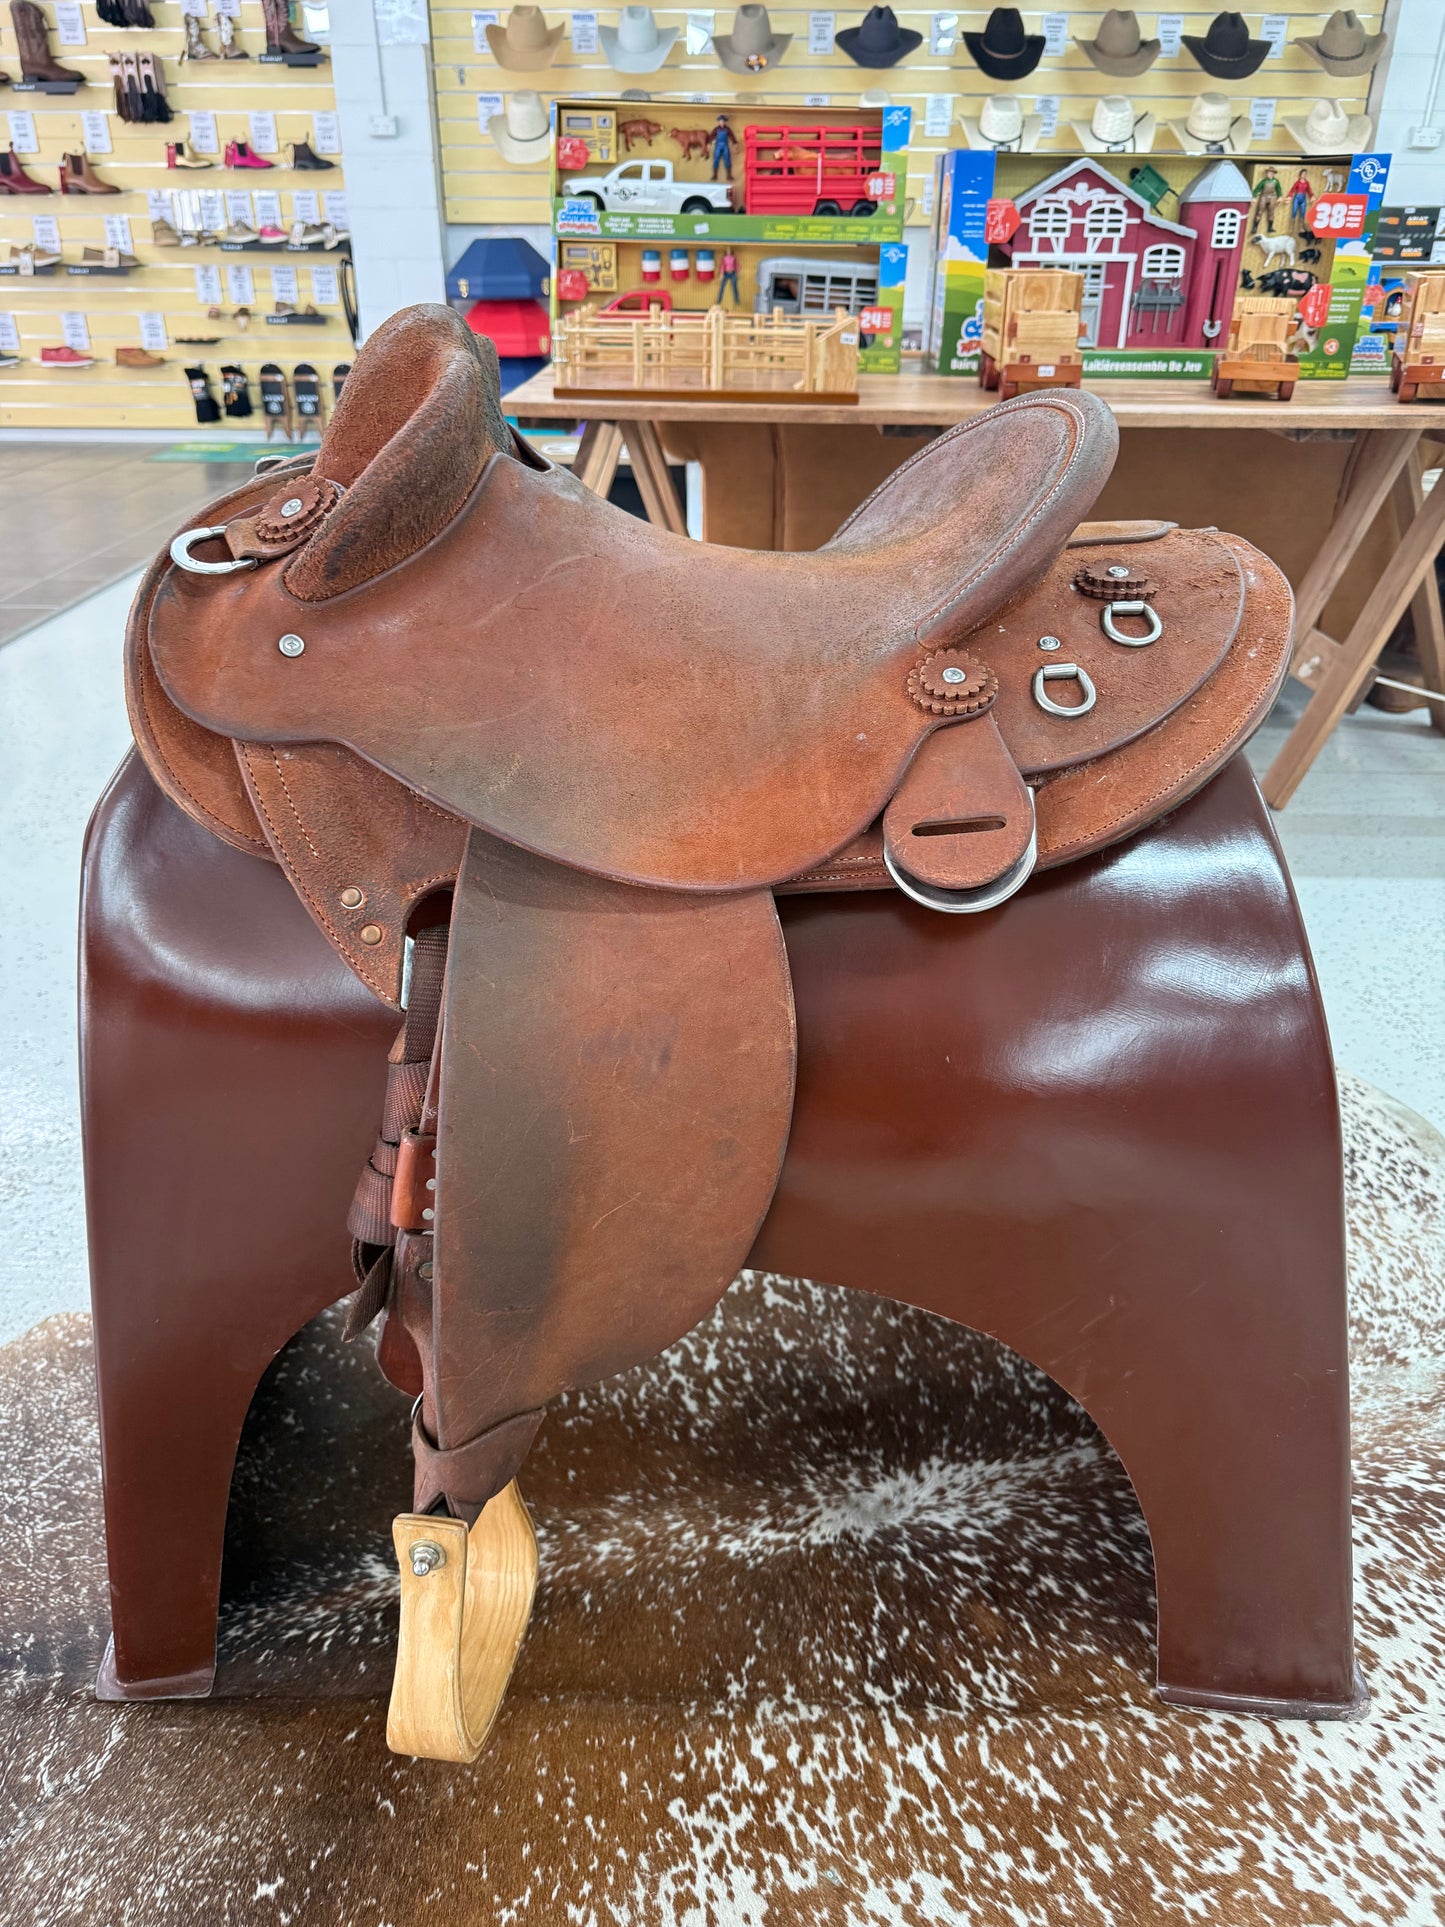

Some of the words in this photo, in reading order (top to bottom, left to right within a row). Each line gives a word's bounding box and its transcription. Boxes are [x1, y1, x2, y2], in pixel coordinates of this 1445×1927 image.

[1312, 202, 1348, 229] 38
[860, 311, 881, 329] 24
[950, 358, 978, 372] Dairy
[1184, 361, 1203, 372] Jeu
